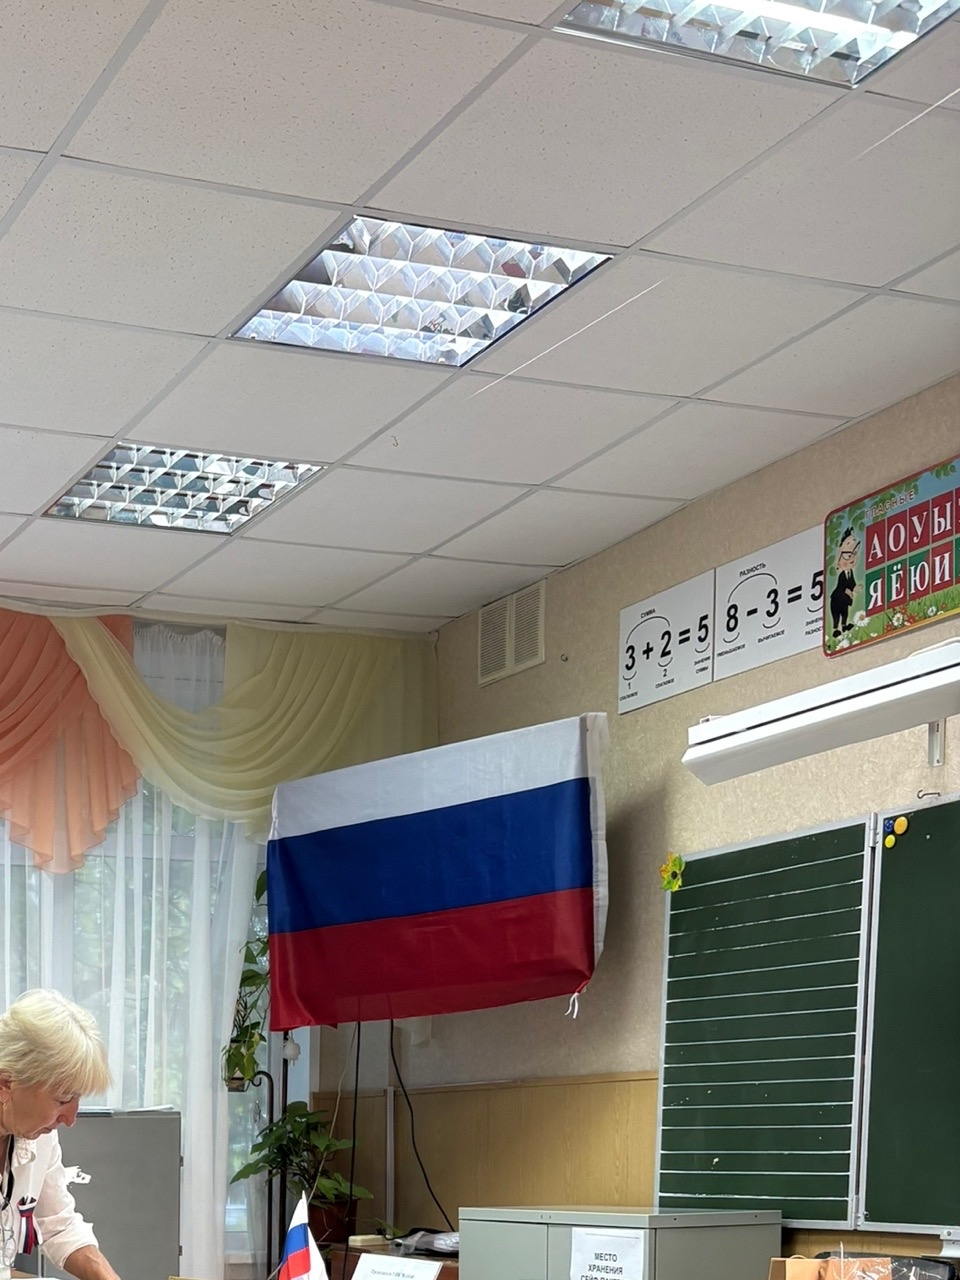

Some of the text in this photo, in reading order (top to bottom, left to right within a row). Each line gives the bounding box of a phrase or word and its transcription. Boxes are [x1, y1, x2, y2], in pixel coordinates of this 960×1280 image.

[864, 488, 915, 521] ГЛАСНЫЕ
[594, 1252, 618, 1262] МЕСТО
[588, 1264, 624, 1275] ХРАНЕНИЯ
